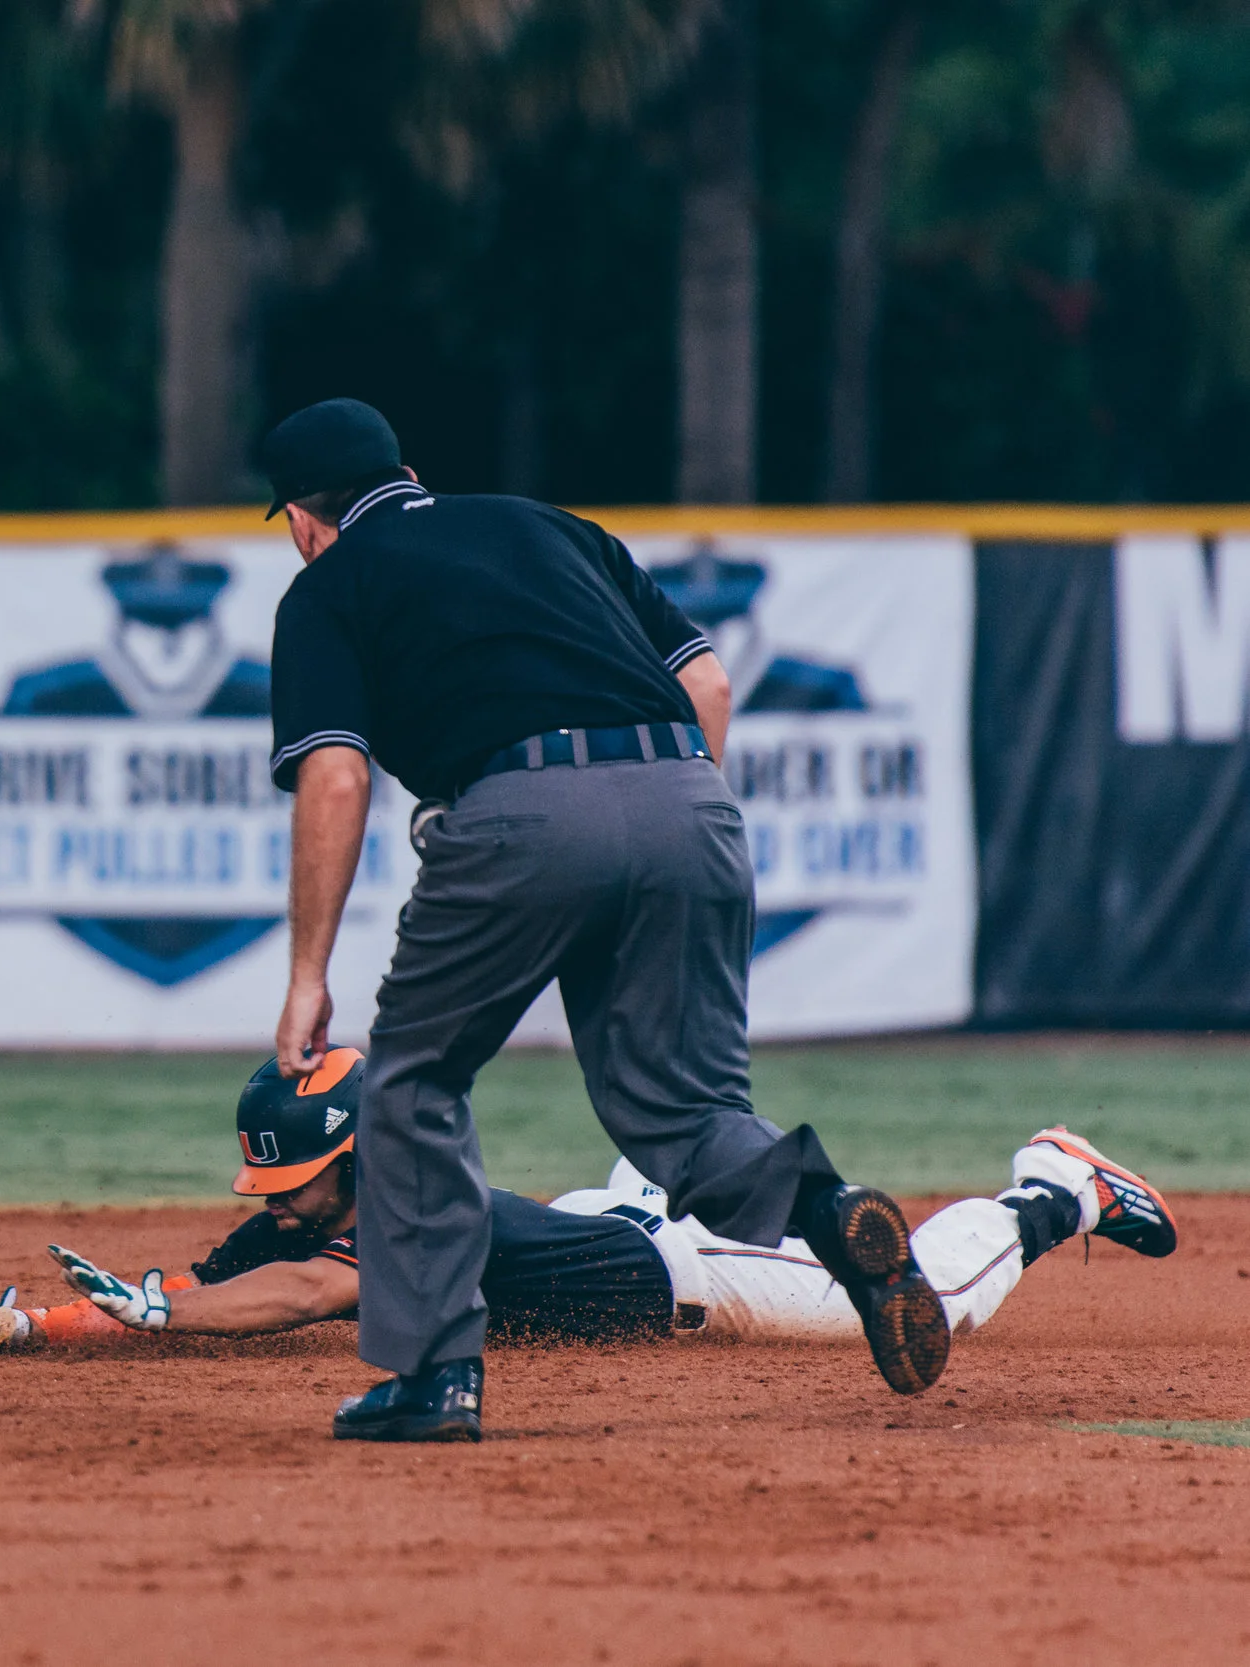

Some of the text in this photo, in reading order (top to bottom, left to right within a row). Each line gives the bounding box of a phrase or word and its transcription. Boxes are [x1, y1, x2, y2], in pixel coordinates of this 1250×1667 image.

[126, 748, 290, 806] SOBE
[54, 825, 242, 885] PULLED
[798, 821, 926, 880] OVER
[238, 1131, 280, 1164] U
